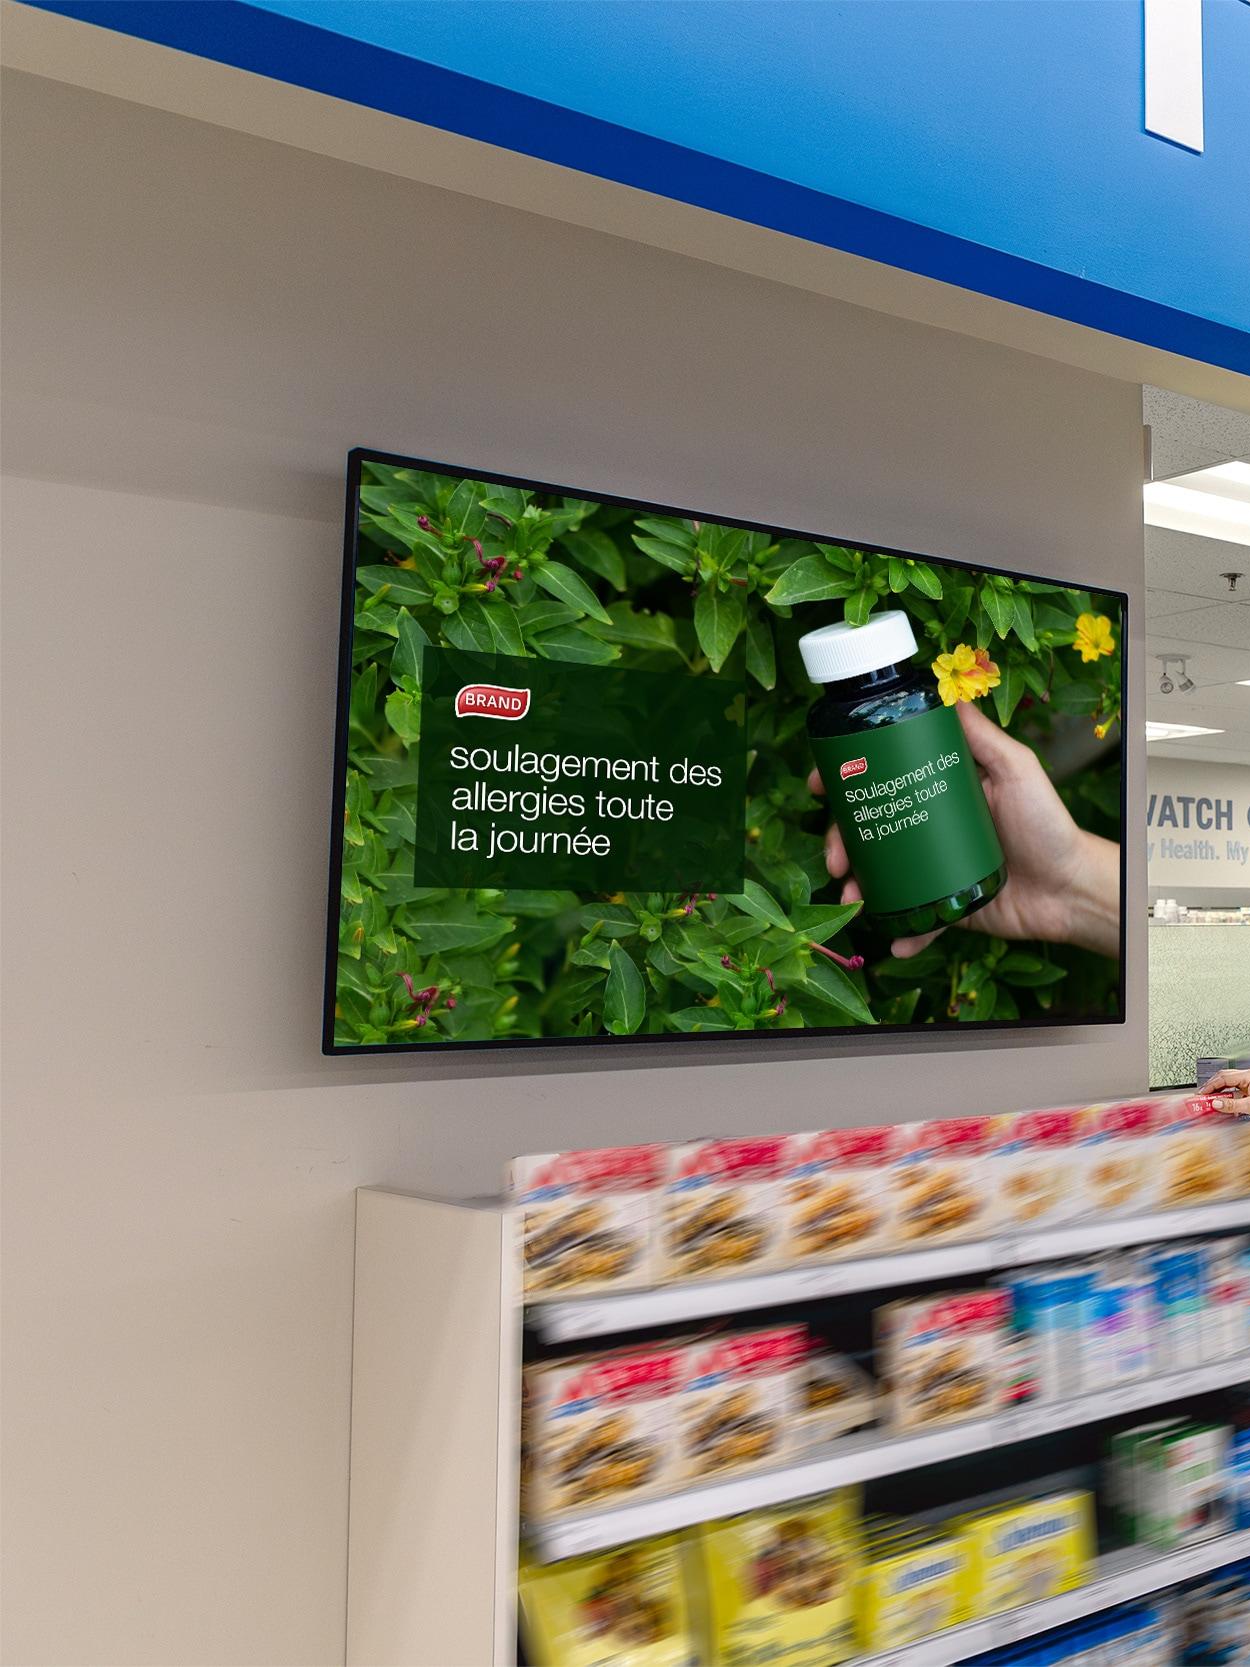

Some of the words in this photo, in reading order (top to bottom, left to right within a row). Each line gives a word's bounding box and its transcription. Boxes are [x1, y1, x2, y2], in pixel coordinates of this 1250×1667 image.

[464, 692, 522, 712] BRAND
[449, 743, 660, 783] soulagement
[669, 757, 723, 788] des
[844, 760, 937, 804] soulagement
[937, 751, 961, 771] des
[451, 781, 586, 822] allergies
[595, 789, 675, 822] toute
[852, 794, 914, 824] allergies
[914, 778, 949, 805] toute
[449, 820, 479, 851] la
[486, 821, 612, 859] journée
[857, 826, 875, 842] la
[875, 808, 930, 841] journée
[1160, 837, 1220, 862] Health.
[1226, 840, 1250, 867] My
